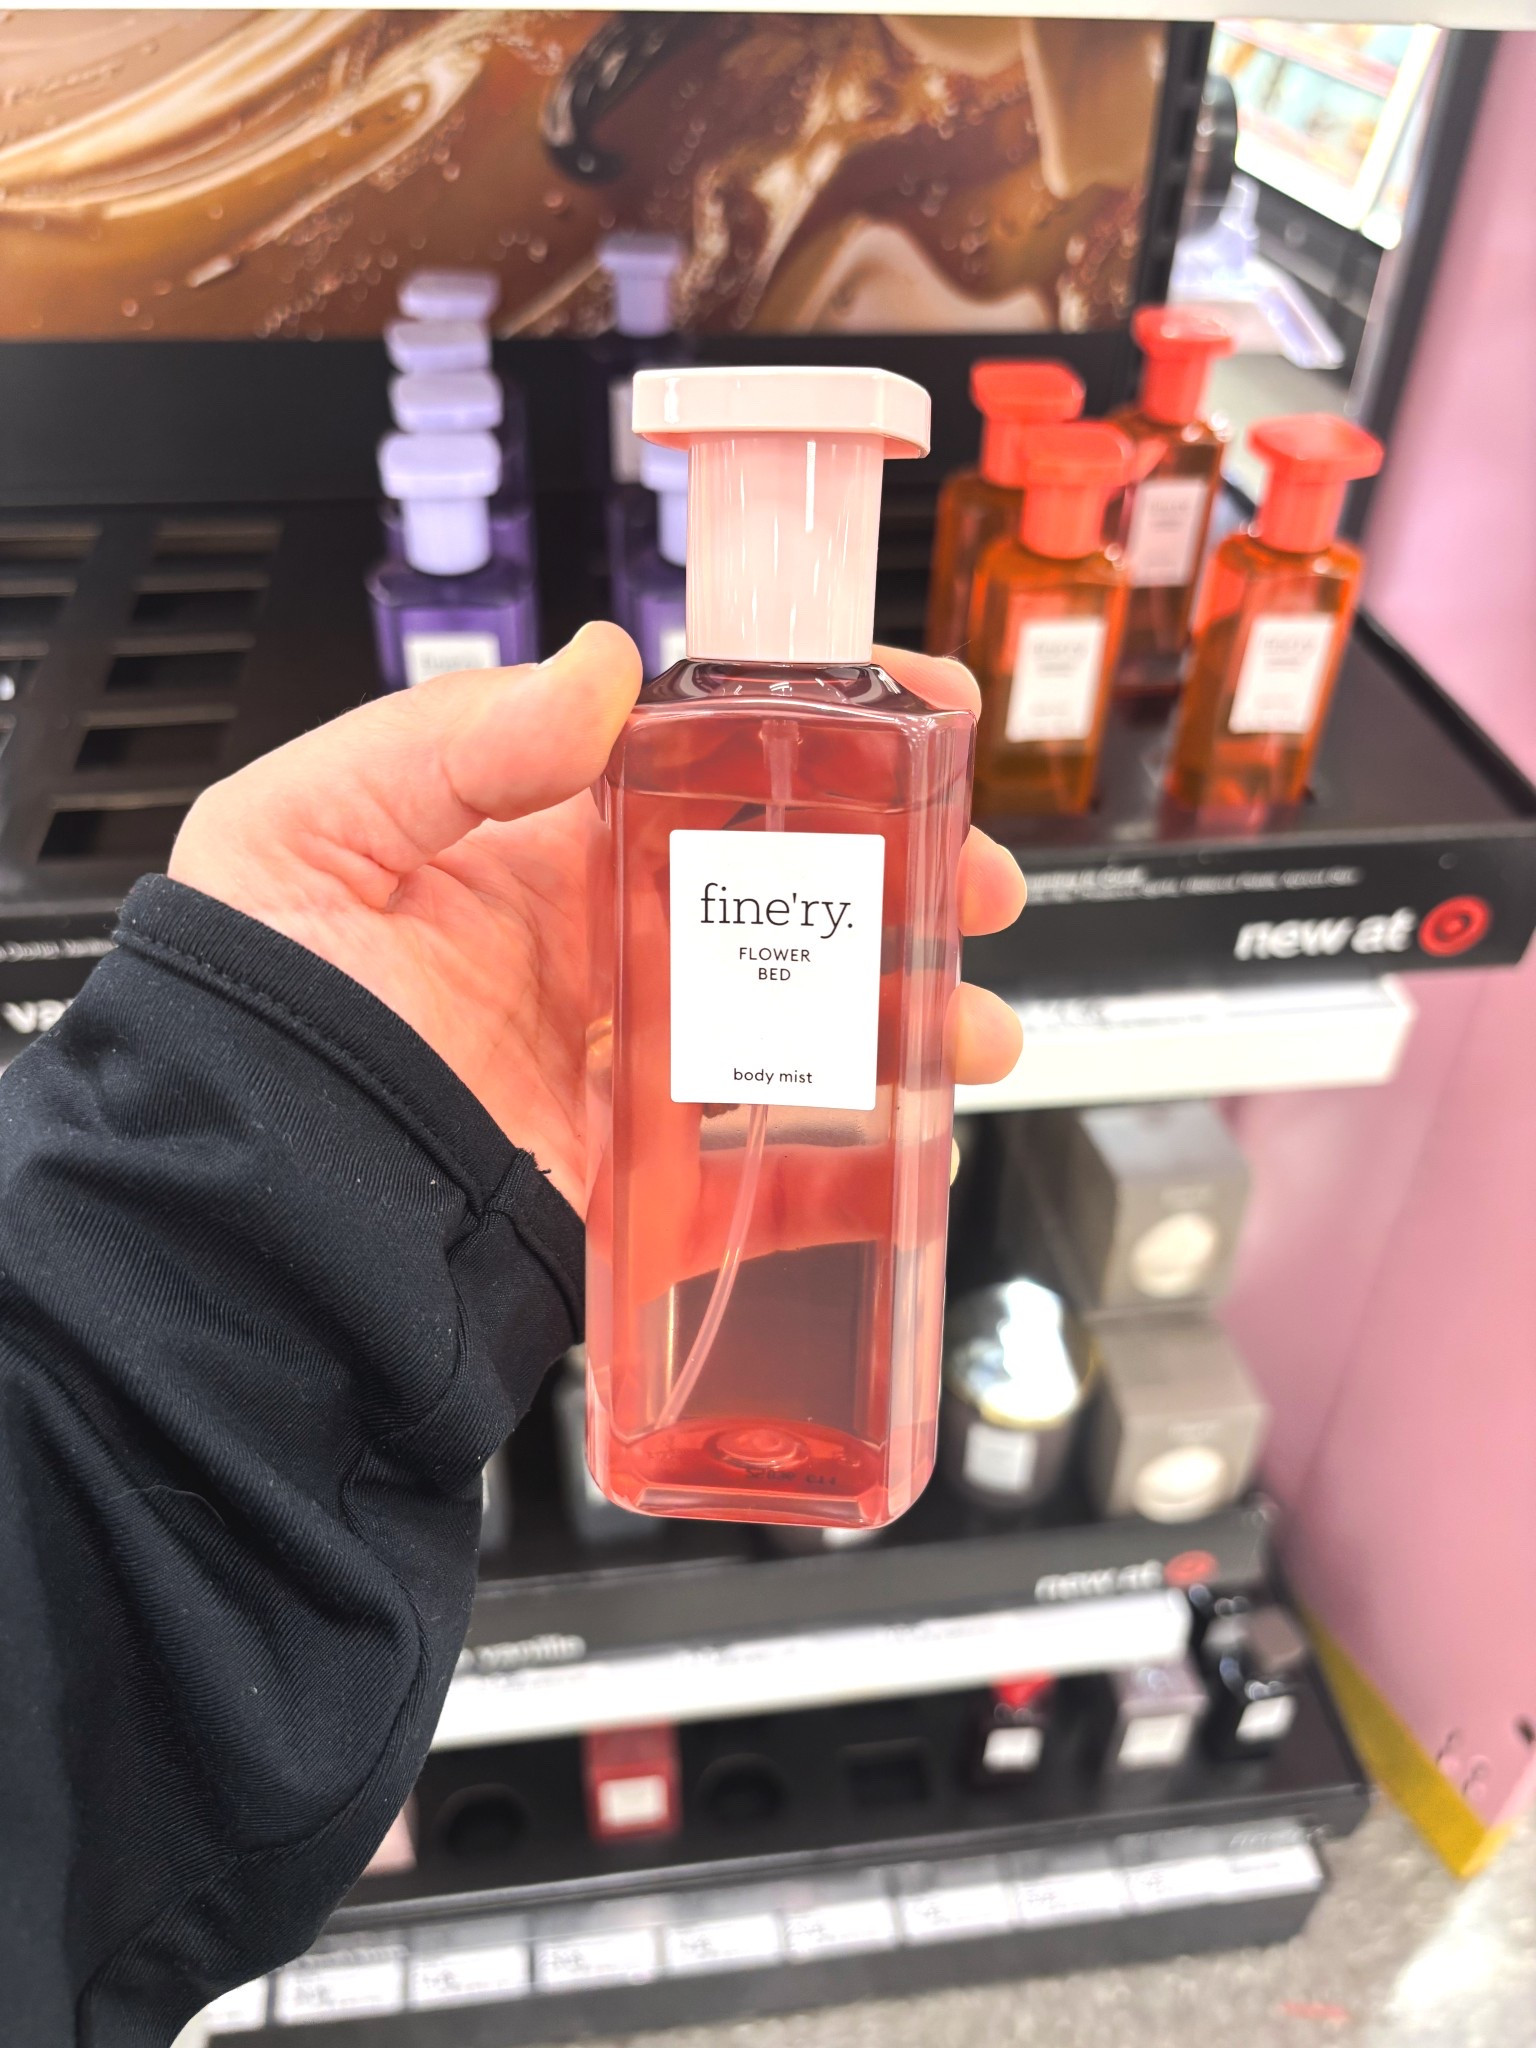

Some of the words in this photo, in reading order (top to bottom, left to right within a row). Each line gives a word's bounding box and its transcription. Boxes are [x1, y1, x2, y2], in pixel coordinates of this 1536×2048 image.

[700, 882, 853, 939] fine'ry.
[1236, 918, 1353, 960] new
[1352, 907, 1417, 954] at
[740, 947, 811, 962] FLOWER
[759, 968, 791, 981] BED
[734, 1068, 774, 1085] body
[780, 1070, 812, 1083] mist
